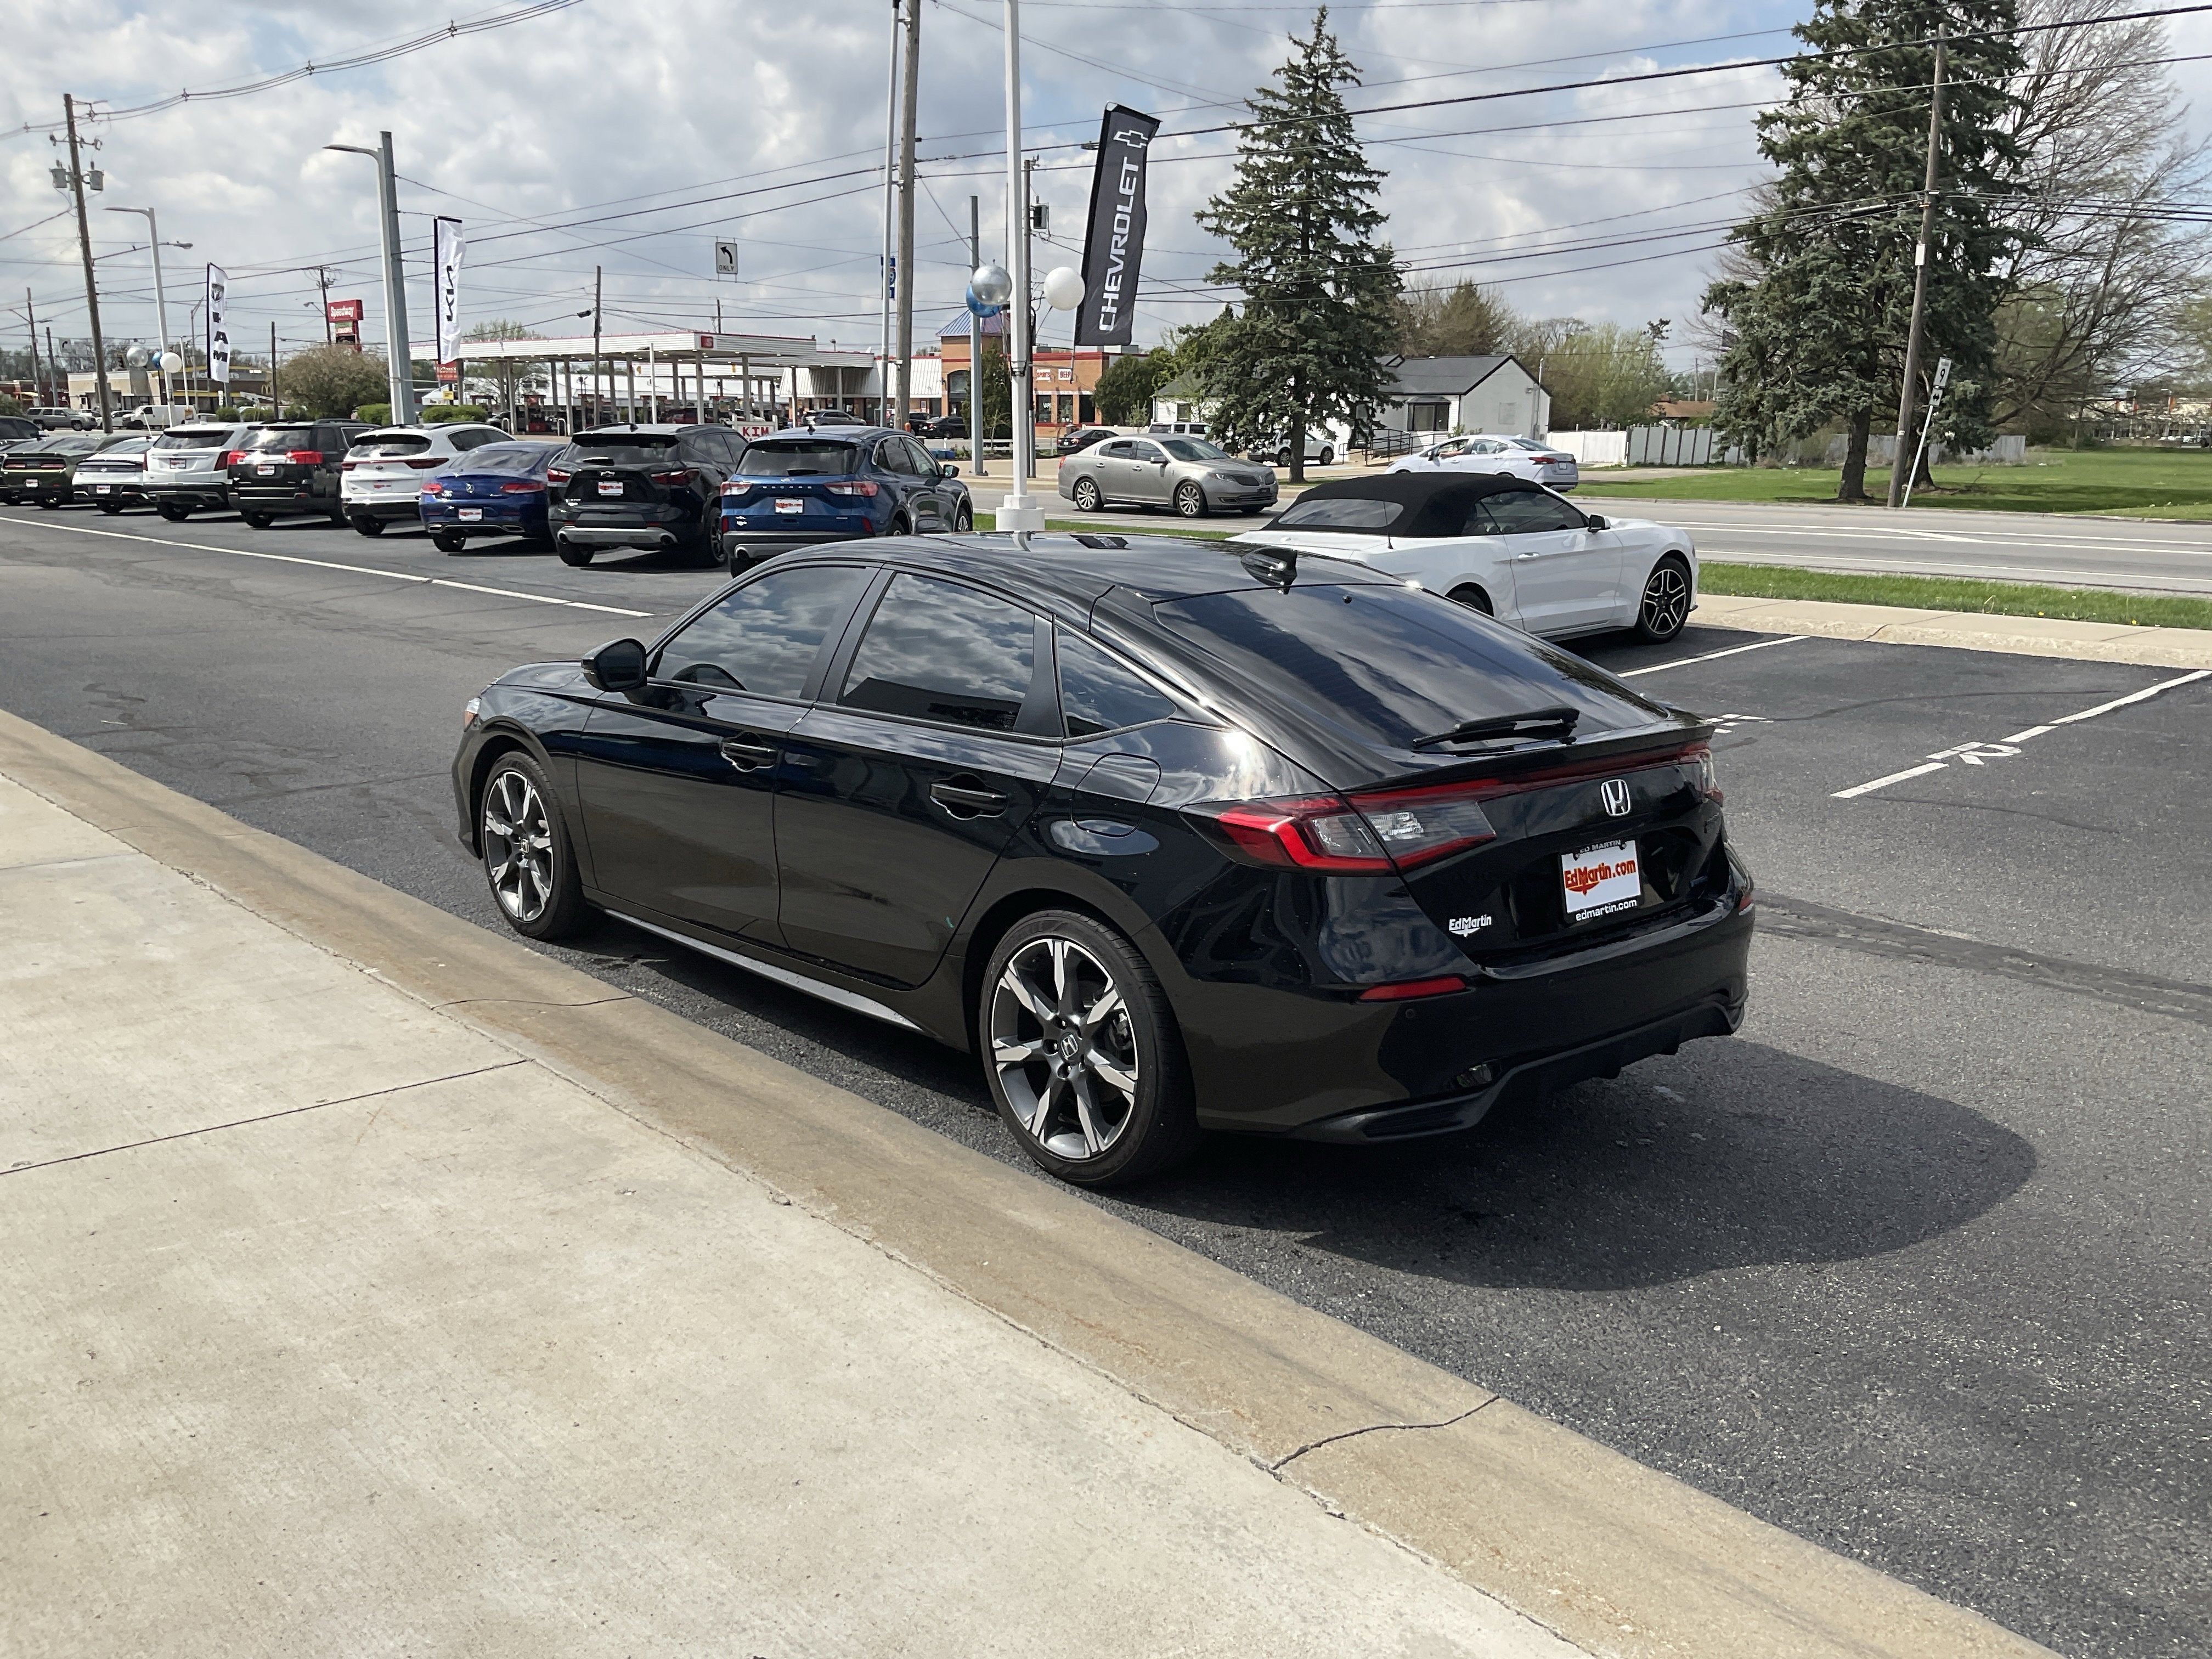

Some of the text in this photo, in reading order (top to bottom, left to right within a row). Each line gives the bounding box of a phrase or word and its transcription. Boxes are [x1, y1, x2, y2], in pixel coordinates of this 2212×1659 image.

[1099, 156, 1139, 331] CHEVROLET
[1940, 368, 1945, 383] 9
[742, 426, 769, 437] KIM
[1592, 839, 1621, 851] MARTIN
[1564, 859, 1637, 889] EdMartin.com
[1576, 899, 1637, 922] edmartin.com
[1449, 914, 1492, 932] EdMartin
